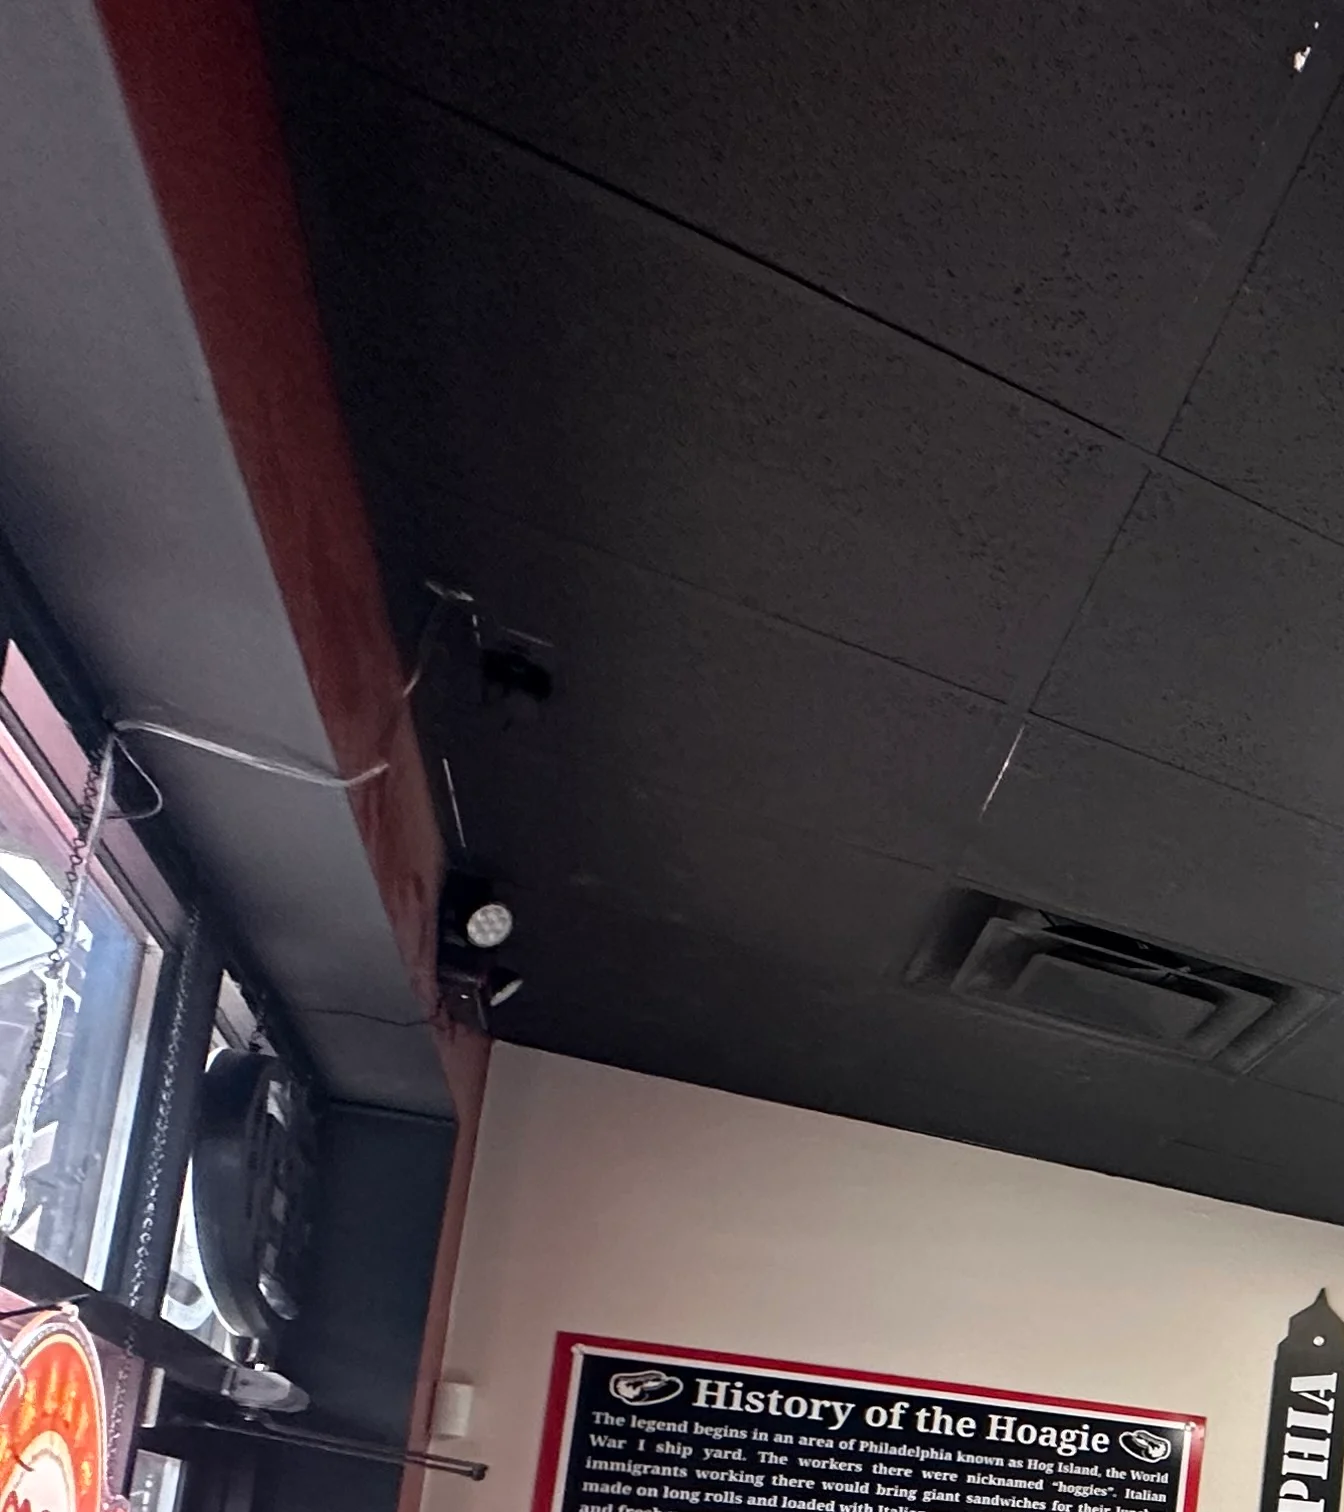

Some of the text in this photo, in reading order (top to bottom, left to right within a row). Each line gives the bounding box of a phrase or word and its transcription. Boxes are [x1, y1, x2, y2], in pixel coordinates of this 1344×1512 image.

[593, 1412, 1169, 1484] The legend begins in an area of Philadelphia known as Hog Island, the World
[692, 1378, 1110, 1457] History of the Hoagie
[582, 1481, 632, 1495] made
[636, 1486, 658, 1497] on
[662, 1485, 701, 1504] long
[704, 1491, 743, 1504] rolls
[746, 1495, 778, 1507] and
[781, 1496, 836, 1512] loaded
[586, 1456, 688, 1477] immigrants
[695, 1469, 765, 1488] working
[771, 1474, 815, 1489] there
[821, 1481, 870, 1494] would
[875, 1483, 918, 1502] bring
[922, 1488, 961, 1503] giant
[965, 1494, 1047, 1510] sandwiches
[1051, 1500, 1073, 1512] for
